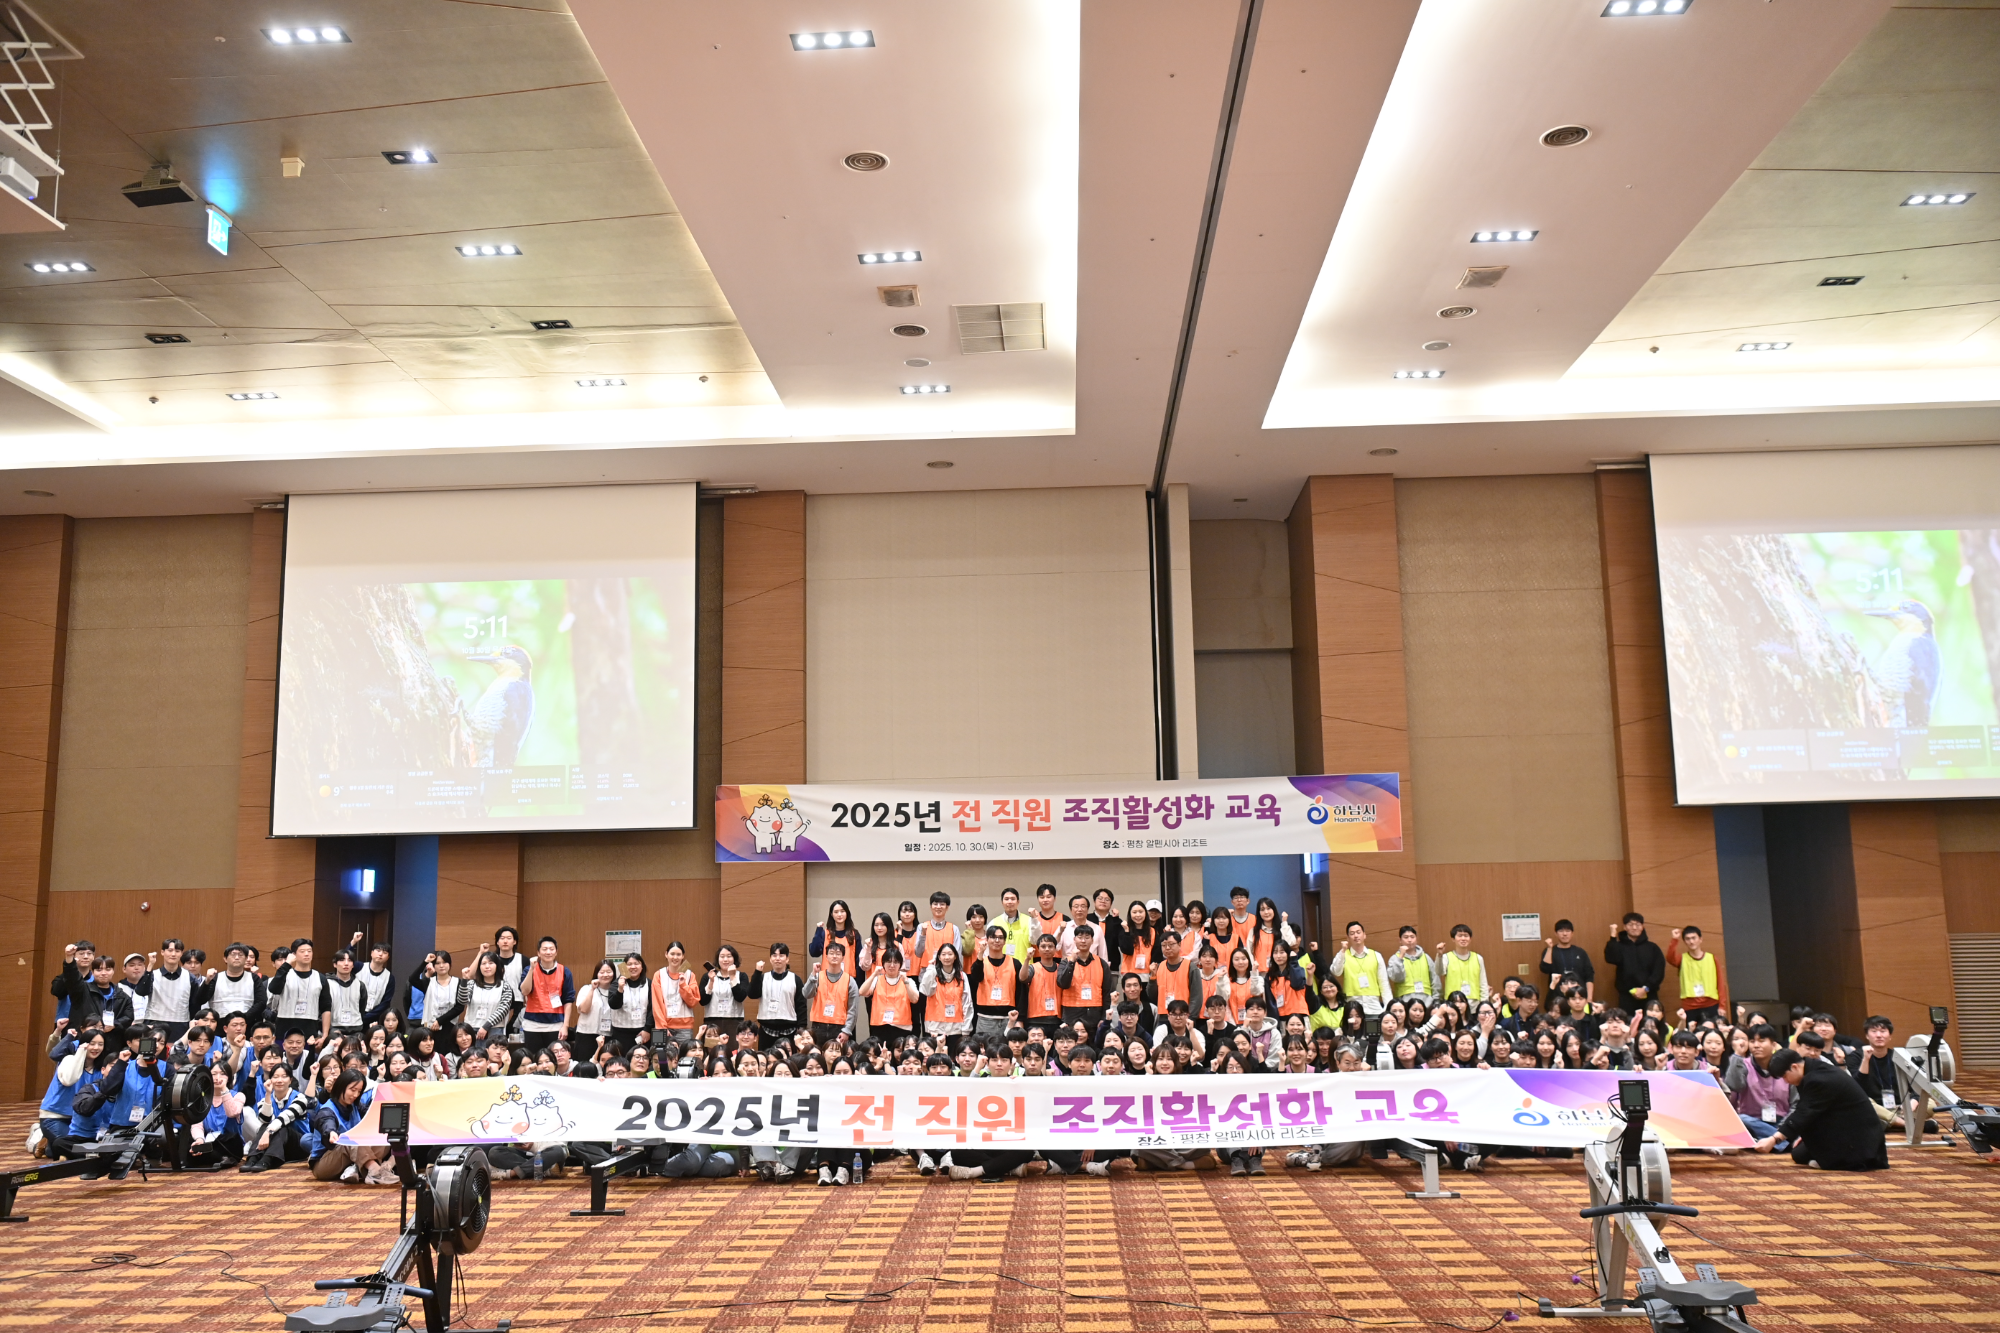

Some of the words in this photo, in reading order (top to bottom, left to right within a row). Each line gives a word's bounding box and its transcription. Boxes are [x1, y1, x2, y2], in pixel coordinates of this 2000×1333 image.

[1855, 567, 1904, 593] 5:11
[462, 615, 508, 639] 5:11
[333, 786, 340, 797] 9
[830, 800, 941, 833] 2025년
[951, 799, 982, 833] 전
[991, 798, 1052, 832] 직원
[1062, 793, 1215, 831] 조직활성화
[1225, 793, 1282, 827] 교육
[1333, 803, 1376, 816] 하남시
[1361, 815, 1376, 823] City
[904, 843, 921, 853] 일정
[928, 842, 954, 852] 2025.
[956, 842, 968, 851] 10.
[1102, 839, 1120, 849] 장소
[1126, 838, 1144, 849] 평창
[1145, 838, 1180, 848] 알펜시아
[1182, 838, 1208, 847] 리조트
[614, 1094, 820, 1143] 2025년
[841, 1095, 895, 1145] 전
[915, 1095, 1026, 1144] 직원
[1138, 1135, 1167, 1147] 장소
[1180, 1132, 1211, 1145] 평창
[1214, 1127, 1276, 1143] 알펜시아
[1280, 1125, 1326, 1139] 리조트
